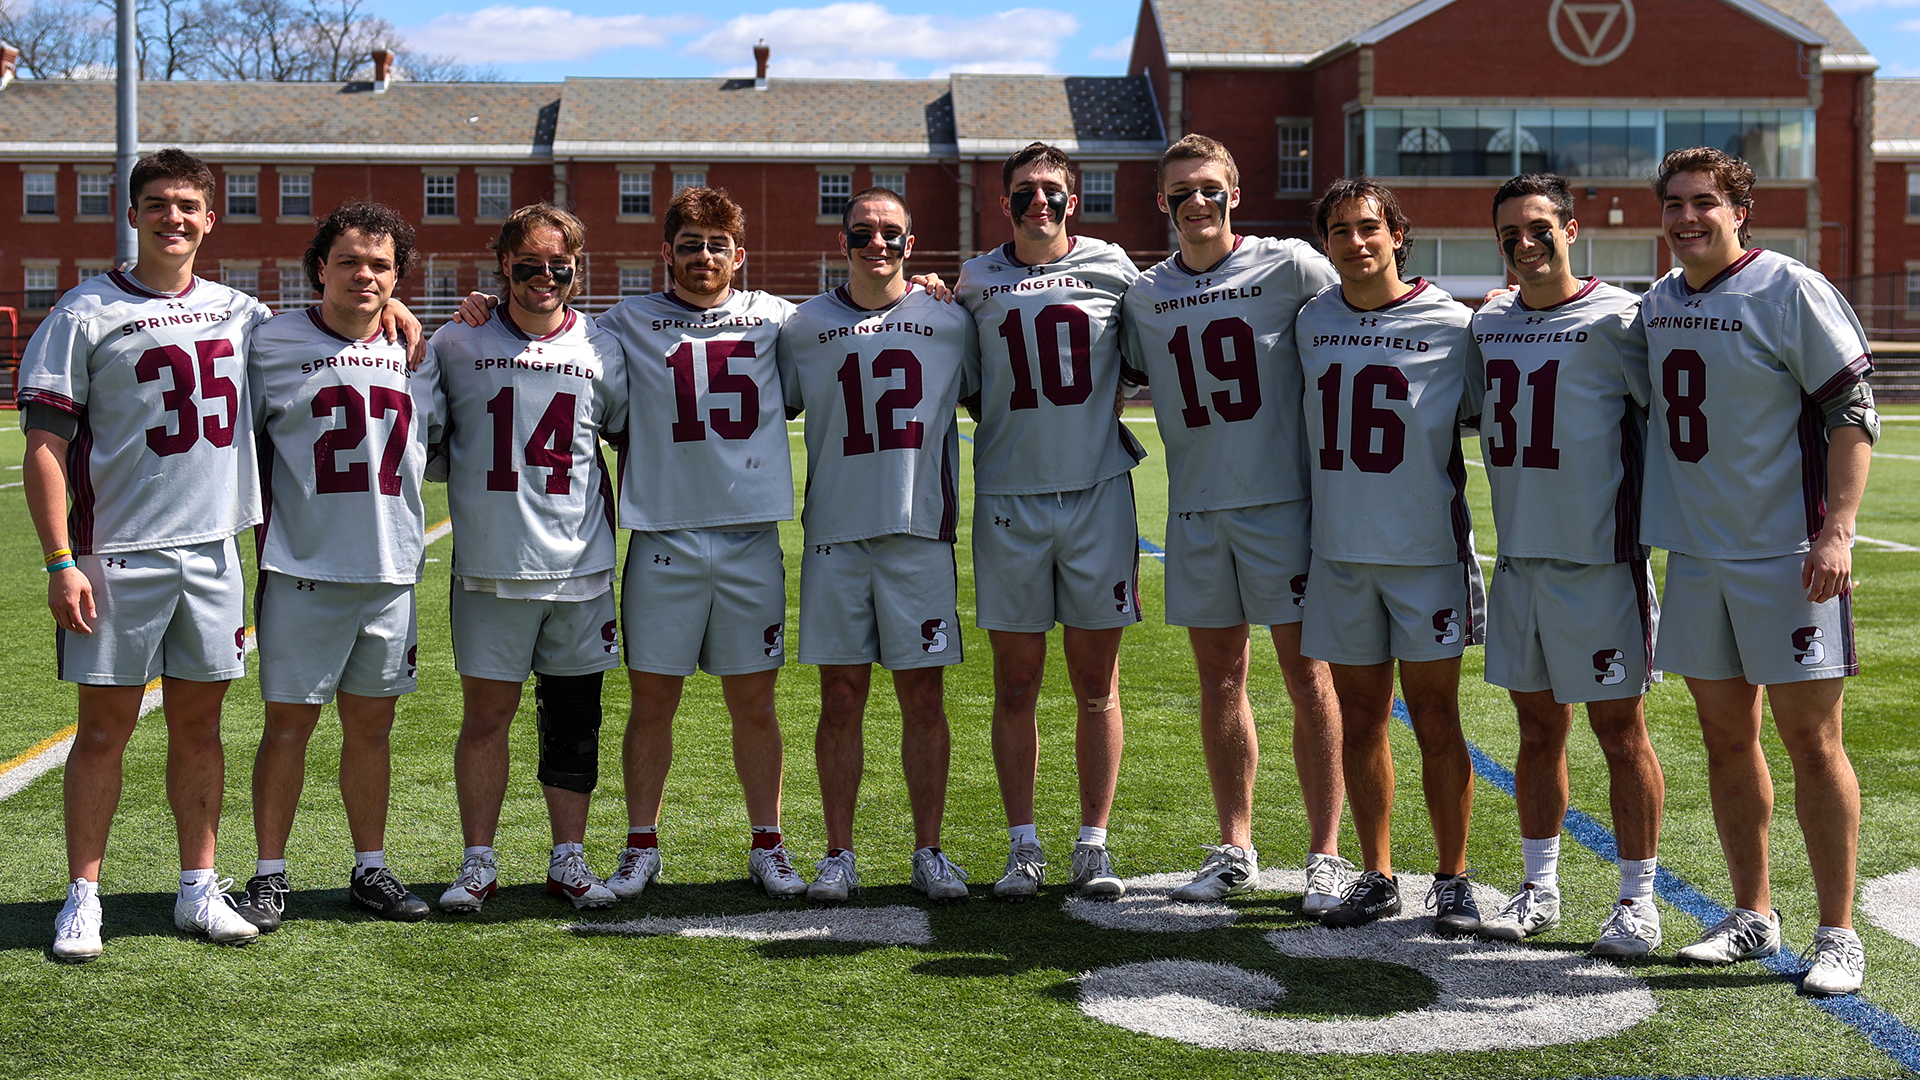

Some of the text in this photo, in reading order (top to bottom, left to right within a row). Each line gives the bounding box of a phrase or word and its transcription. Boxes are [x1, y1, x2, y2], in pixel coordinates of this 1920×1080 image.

[982, 277, 1094, 301] SPRINGFIELD
[1154, 285, 1263, 315] SPRINGFIELD
[122, 310, 232, 336] SPRINGFIELD
[817, 321, 935, 344] SPRINGFIELD
[1312, 335, 1430, 353] SPRINGFIELD
[1475, 331, 1589, 345] SPRINGFIELD
[1647, 316, 1744, 332] SPRINGFIELD
[300, 355, 413, 379] SPRINGFIELD
[474, 357, 595, 380] SPRINGFIELD
[665, 339, 760, 443] 15
[998, 304, 1093, 411] 10
[1167, 316, 1262, 429] 19
[134, 338, 238, 457] 35
[837, 349, 925, 457] 12
[1317, 362, 1409, 474] 16
[1485, 358, 1561, 470] 31
[1661, 348, 1710, 464] 8
[310, 384, 412, 497] 27
[485, 386, 577, 495] 14
[1364, 904, 1378, 916] new
